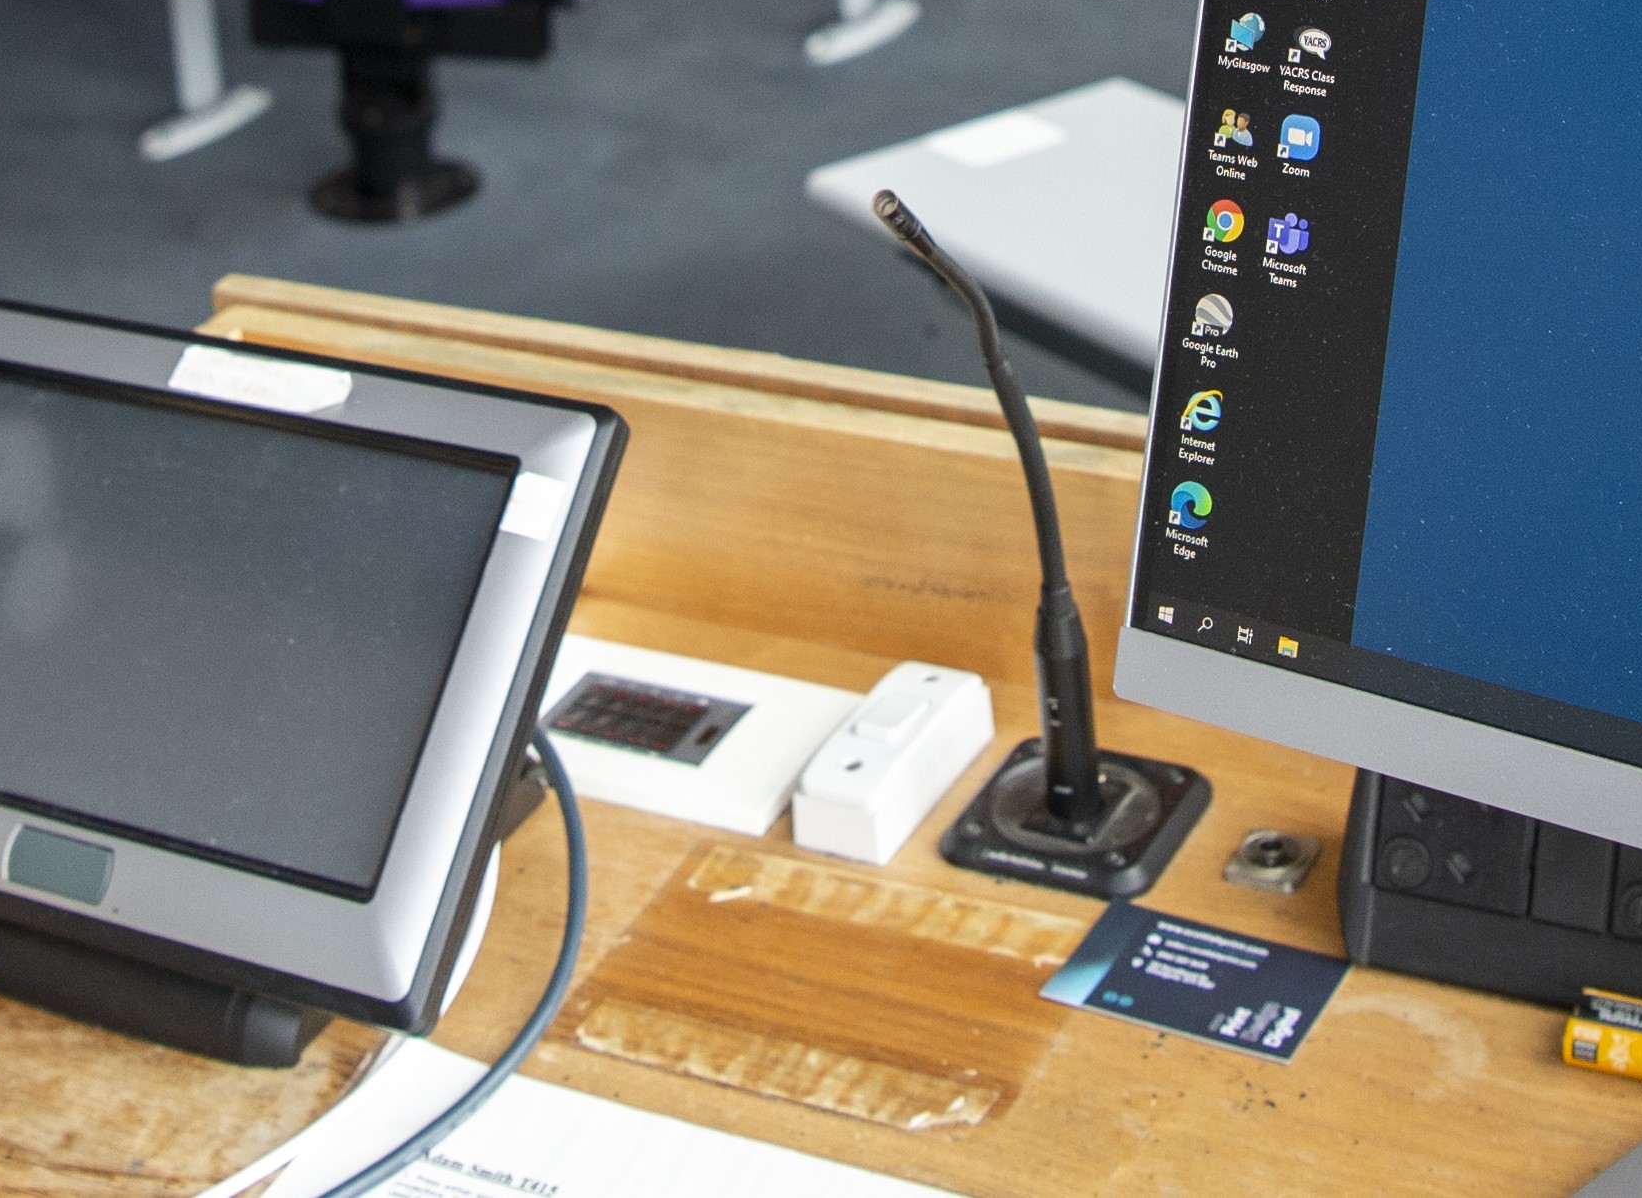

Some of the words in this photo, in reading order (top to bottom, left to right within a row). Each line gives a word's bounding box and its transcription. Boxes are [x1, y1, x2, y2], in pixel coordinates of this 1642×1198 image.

[1303, 34, 1327, 47] YACRS
[1218, 55, 1270, 73] MyGlasgow
[1280, 65, 1309, 79] YACRS
[1312, 70, 1335, 83] Class
[1284, 79, 1327, 96] Response
[1208, 149, 1235, 164] Teams
[1238, 155, 1257, 168] Web
[1216, 165, 1245, 180] Online
[1282, 163, 1309, 177] Zoom
[1204, 246, 1237, 262] Google
[1202, 259, 1237, 275] Chrome
[1263, 257, 1306, 276] Microsoft
[1269, 272, 1298, 288] Teams
[1205, 325, 1219, 336] Pro
[1182, 338, 1214, 354] Google
[1216, 345, 1238, 359] Earth
[1201, 356, 1216, 368] Pro
[1180, 434, 1215, 452] Internet
[1179, 448, 1215, 465] Explorer
[1166, 527, 1208, 548] Microsoft
[1174, 544, 1195, 560] Edge
[419, 1147, 464, 1171] Adam
[469, 1164, 513, 1185] Smith
